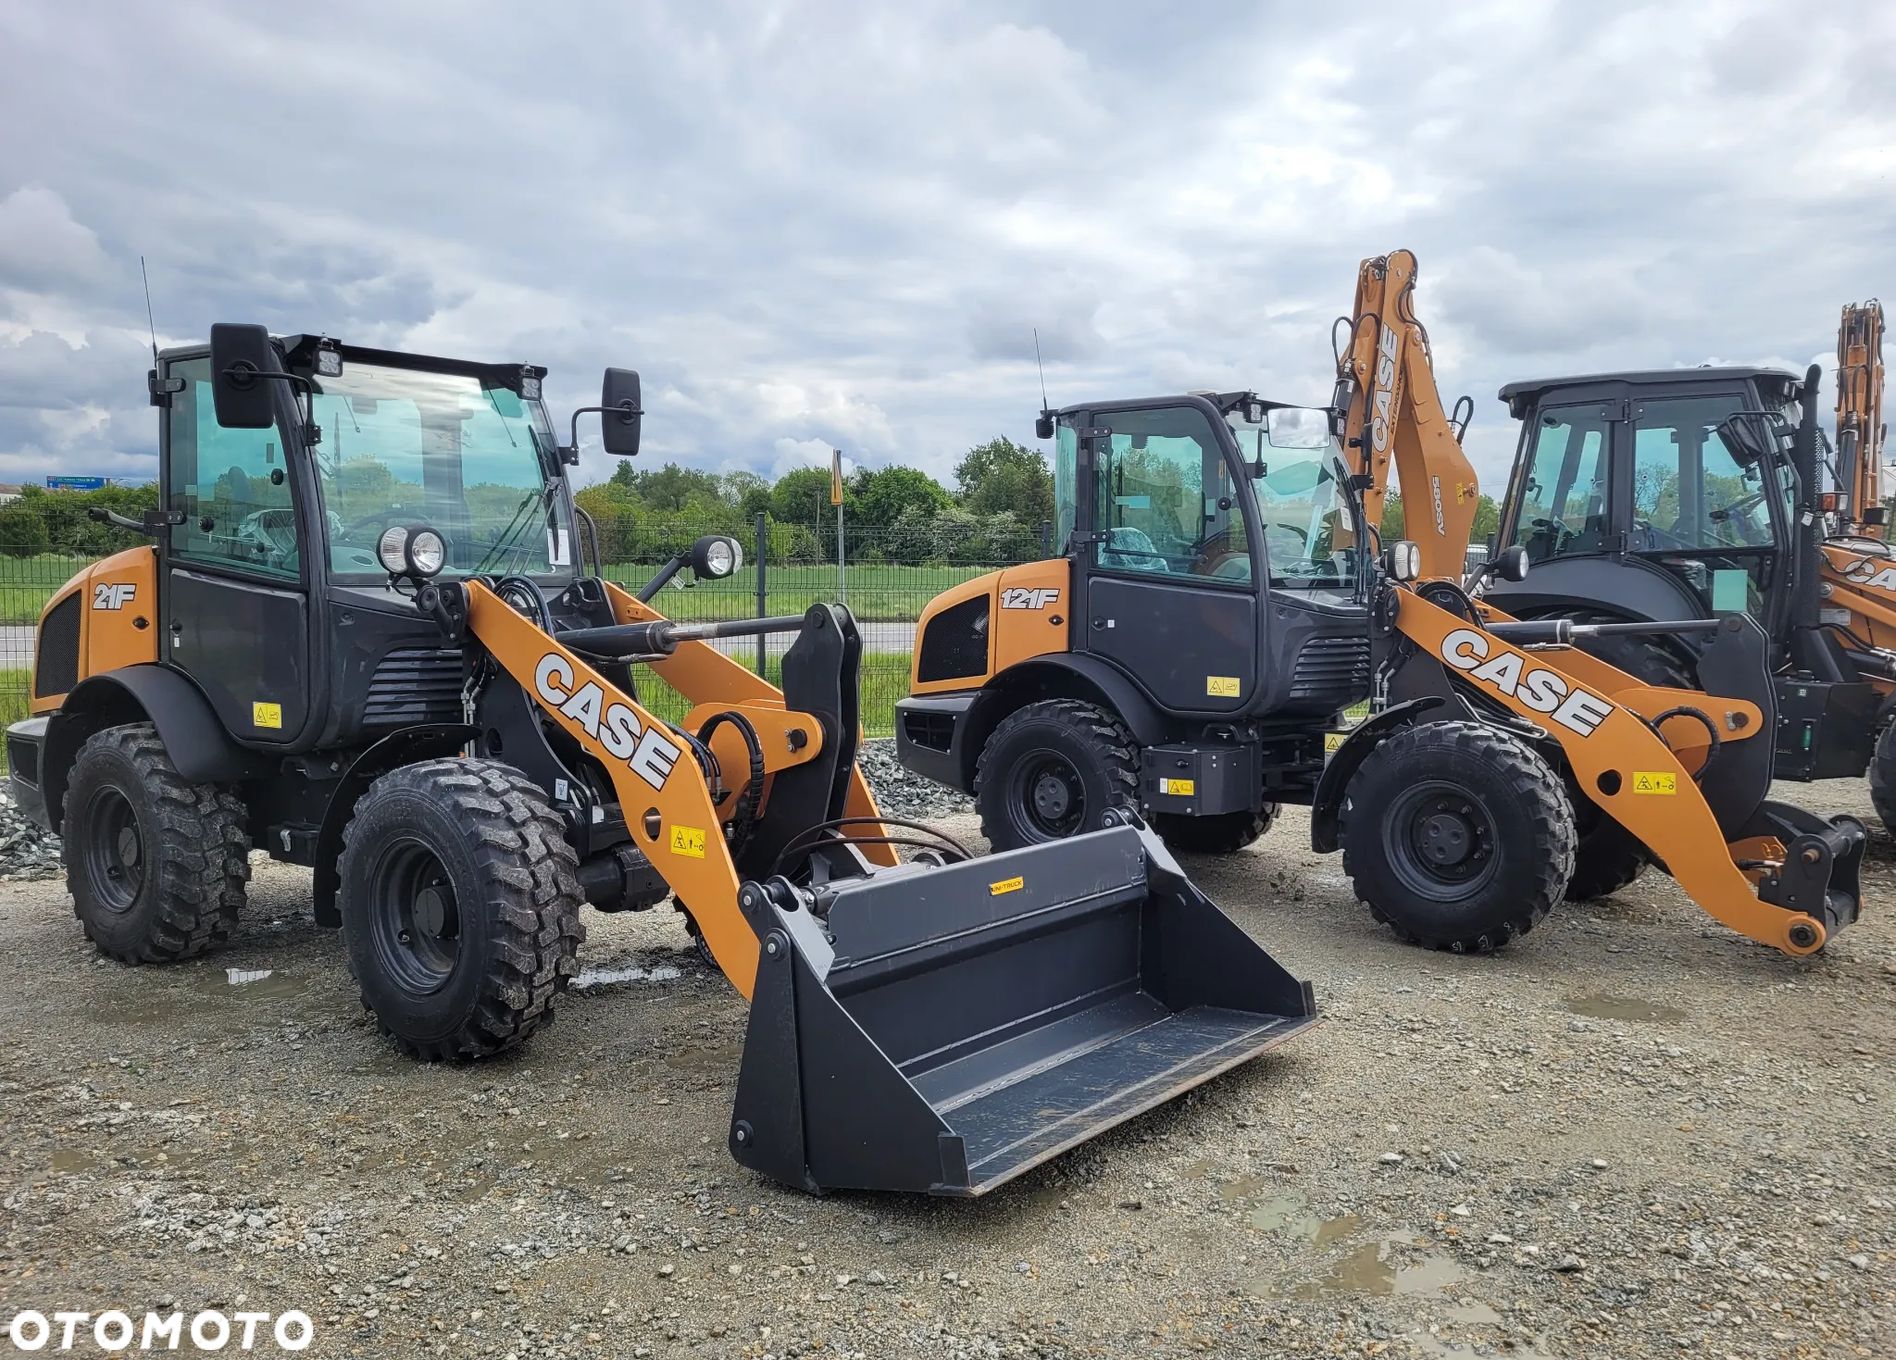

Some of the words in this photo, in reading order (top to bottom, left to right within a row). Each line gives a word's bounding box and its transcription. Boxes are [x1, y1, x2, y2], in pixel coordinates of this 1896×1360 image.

[1372, 321, 1398, 452] CASE
[1432, 474, 1445, 536] 580SV
[92, 582, 137, 610] 21F
[1001, 587, 1060, 610] 121F
[534, 652, 682, 792] CASE
[1441, 628, 1616, 738] CASE
